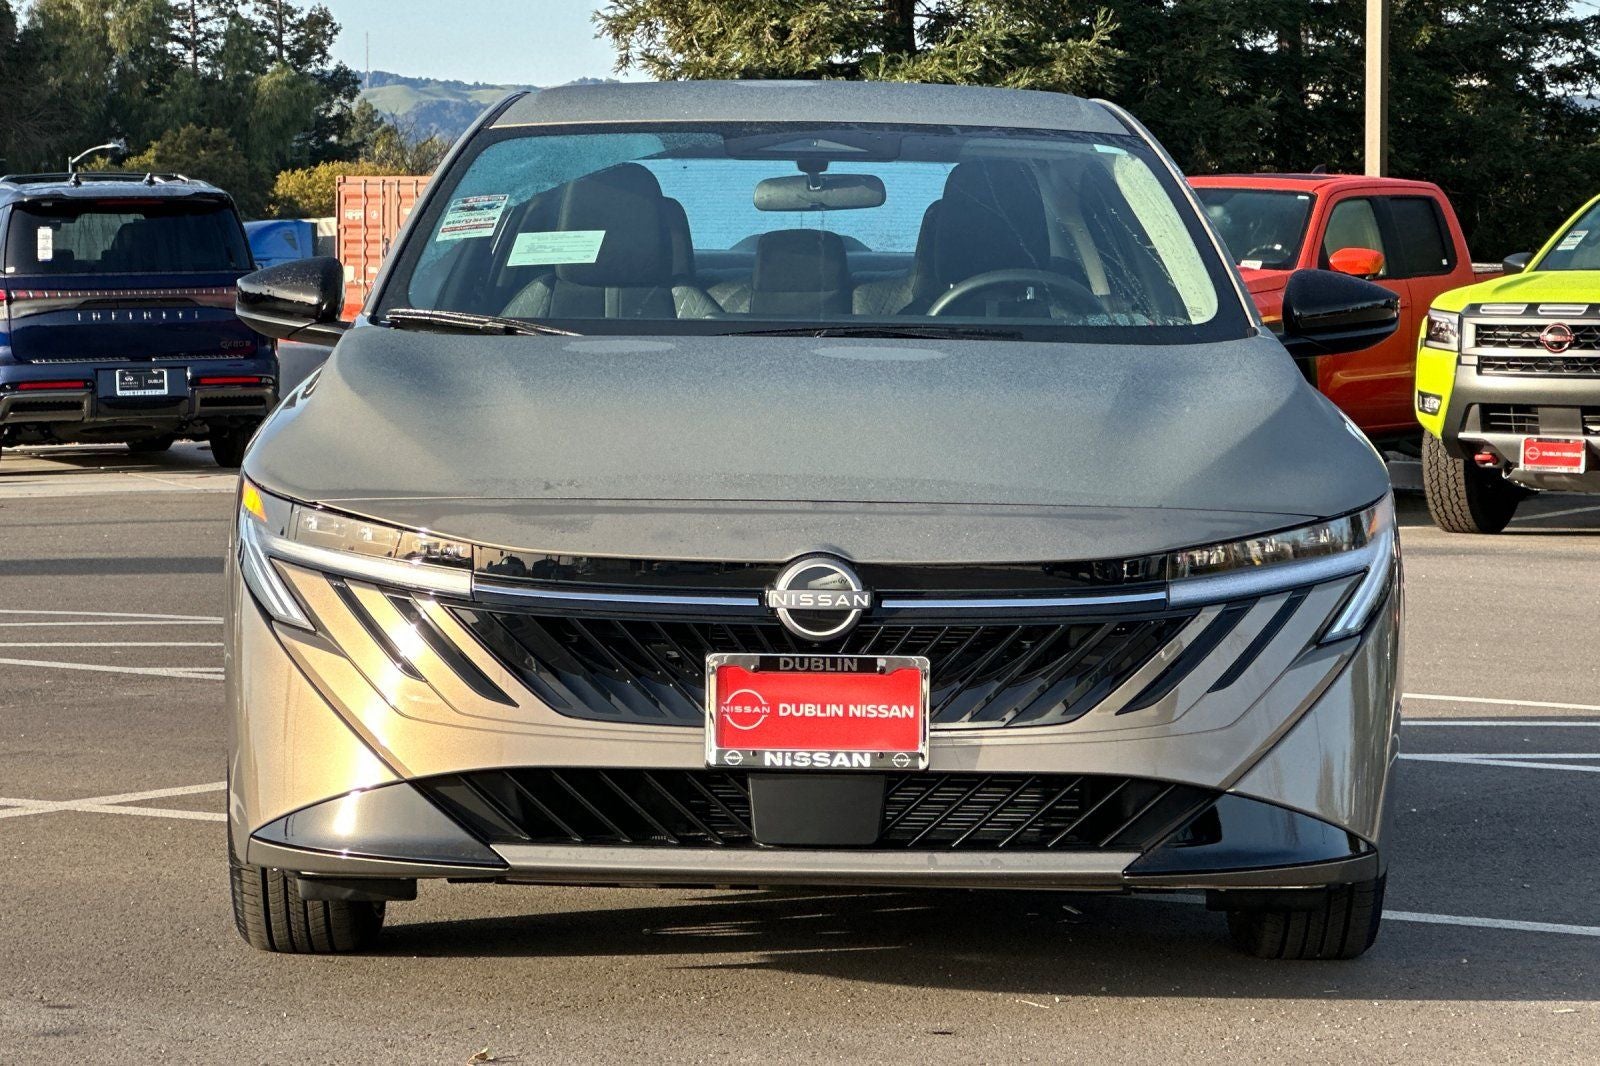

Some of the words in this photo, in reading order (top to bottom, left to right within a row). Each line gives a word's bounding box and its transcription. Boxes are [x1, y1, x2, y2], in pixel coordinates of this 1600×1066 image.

[771, 593, 869, 607] NISSAN
[779, 657, 858, 672] DUBLIN
[720, 705, 770, 714] NISSAN
[778, 703, 844, 718] DUBLIN
[848, 704, 914, 719] NISSAN
[764, 751, 871, 768] NISSAN
